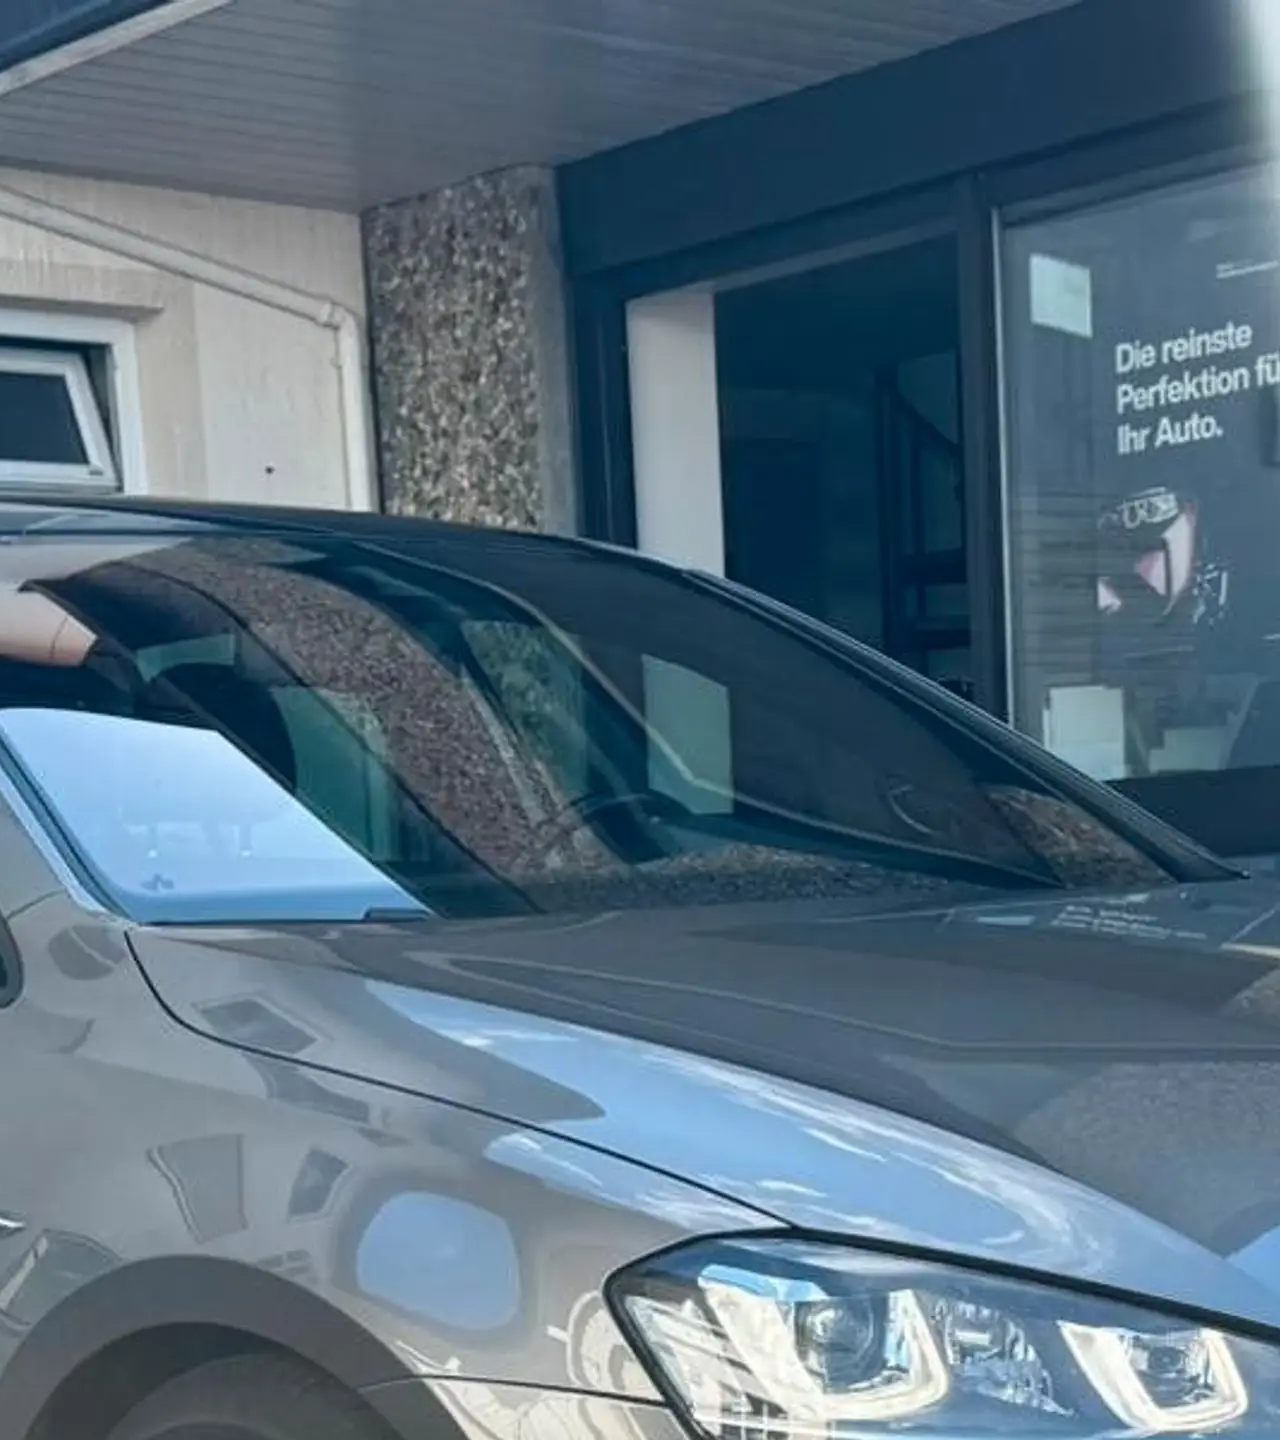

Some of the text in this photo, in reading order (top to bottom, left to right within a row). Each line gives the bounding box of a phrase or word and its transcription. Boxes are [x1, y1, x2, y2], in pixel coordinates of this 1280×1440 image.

[1116, 321, 1253, 374] Die reinste
[1116, 363, 1250, 414] Perfektion
[1117, 411, 1224, 455] Ihr Auto.
